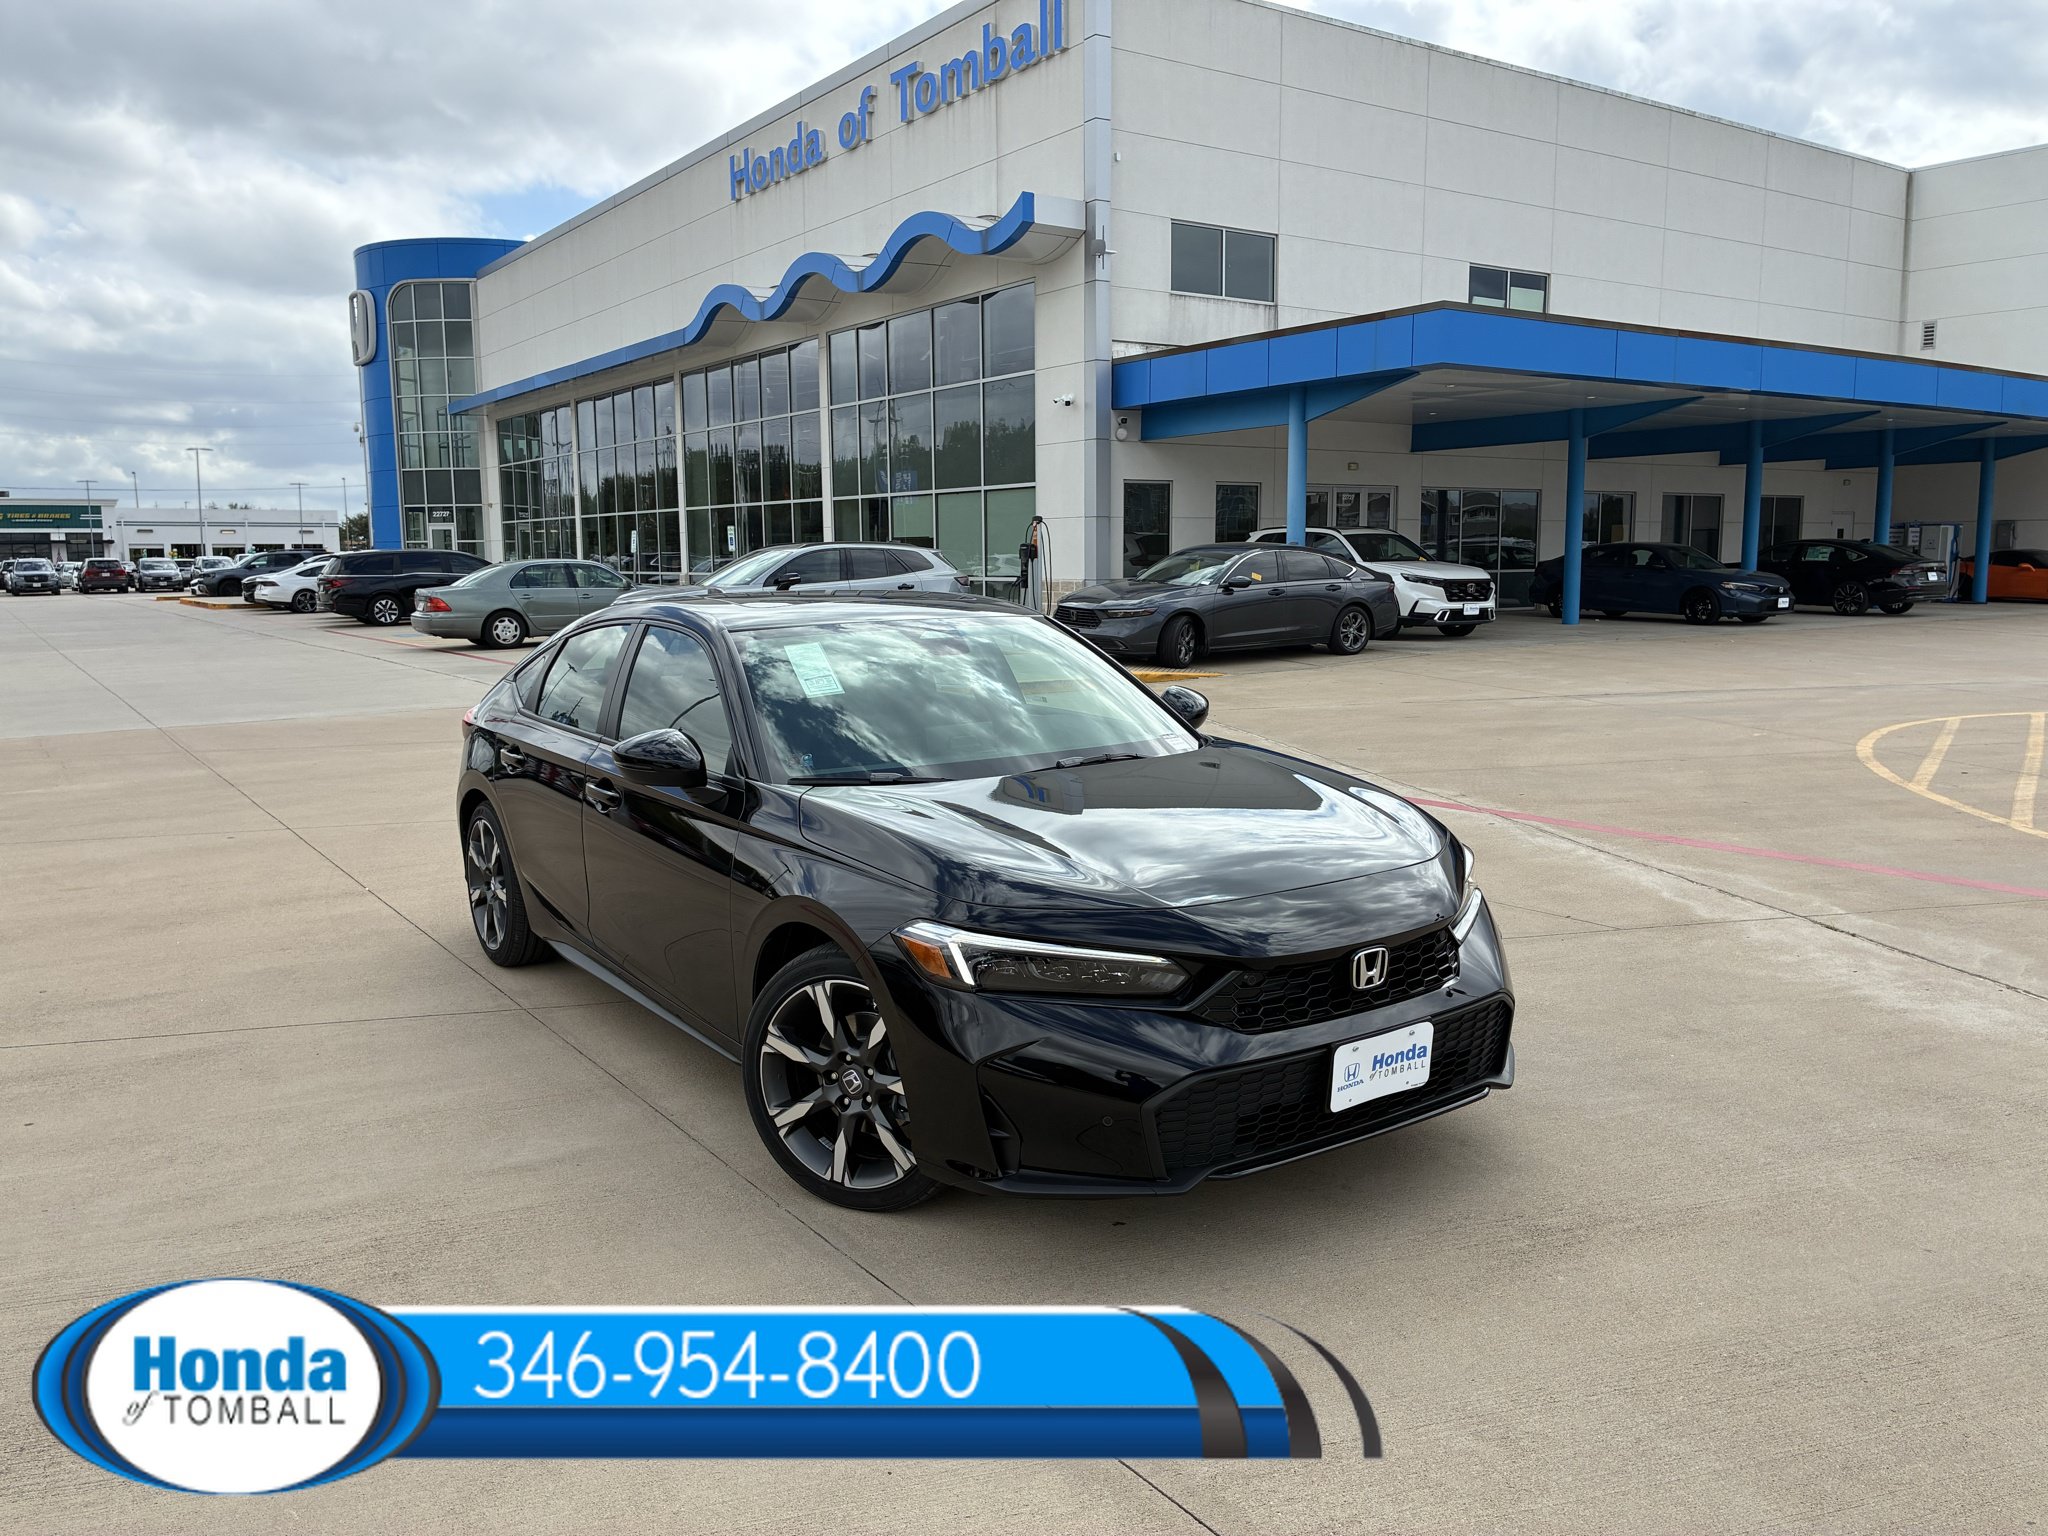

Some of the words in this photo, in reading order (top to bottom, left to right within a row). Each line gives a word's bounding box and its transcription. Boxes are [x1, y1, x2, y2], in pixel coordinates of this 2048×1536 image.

[729, 121, 828, 201] Honda
[838, 85, 877, 150] of
[890, 0, 1069, 123] Tomball
[1371, 1043, 1428, 1072] Honda
[1378, 1060, 1426, 1080] TOMBALL
[1337, 1079, 1364, 1092] HONDA
